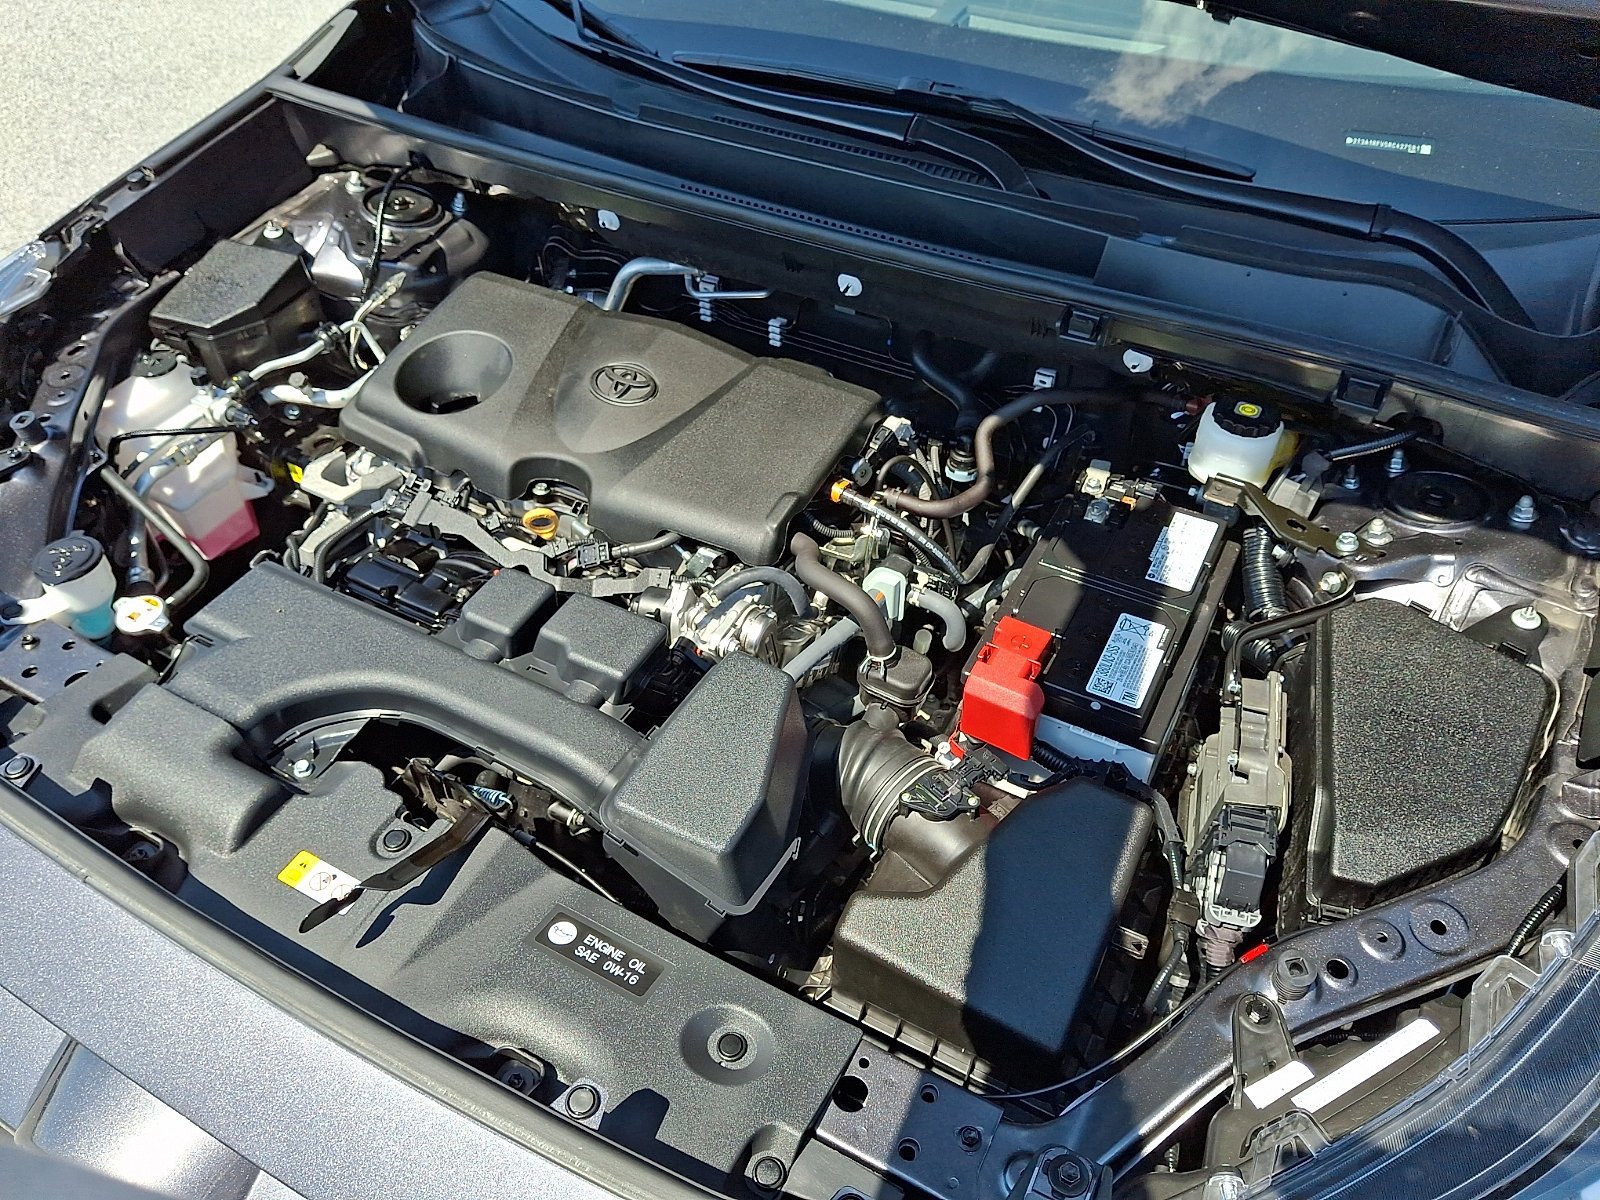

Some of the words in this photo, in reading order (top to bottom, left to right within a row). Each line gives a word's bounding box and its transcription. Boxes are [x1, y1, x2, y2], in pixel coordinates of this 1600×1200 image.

[574, 945, 601, 965] SAE
[602, 961, 640, 985] 0W-16
[583, 933, 627, 962] ENGINE
[628, 958, 647, 975] OIL
